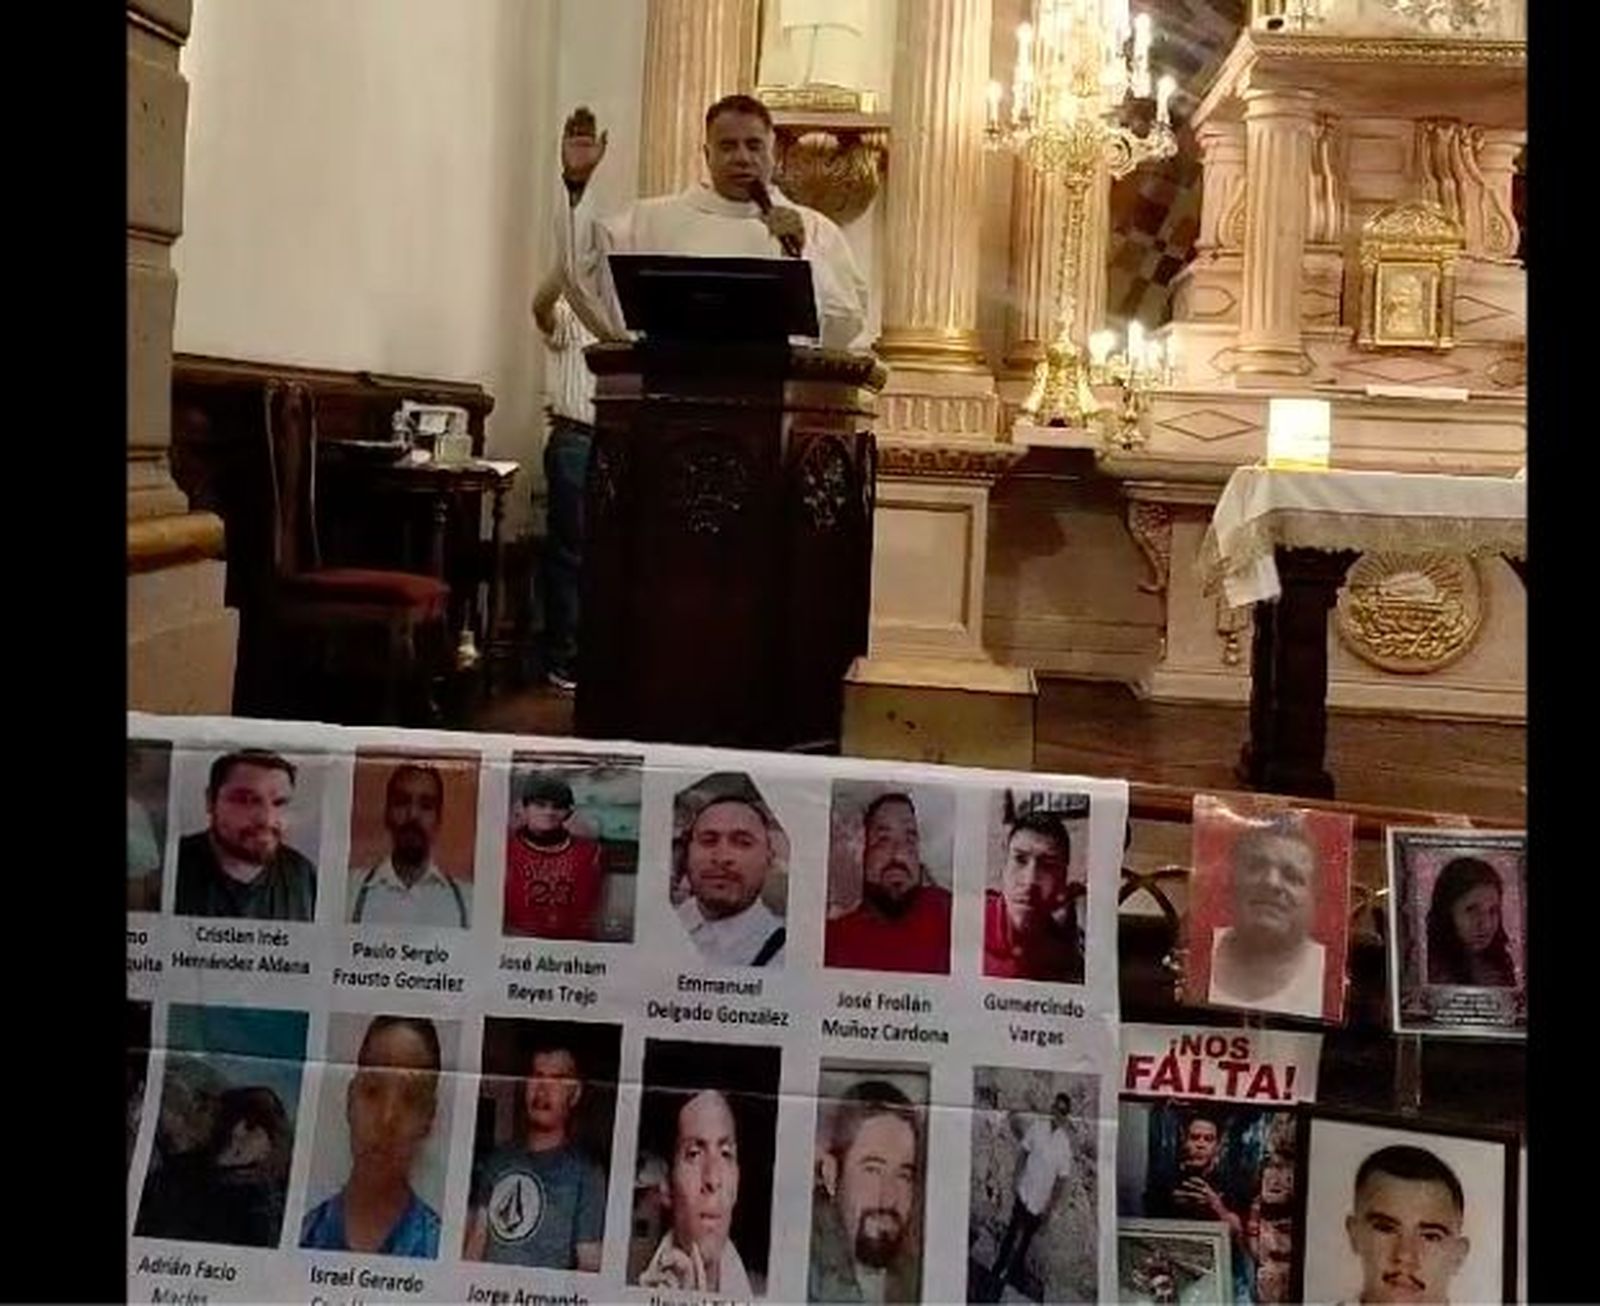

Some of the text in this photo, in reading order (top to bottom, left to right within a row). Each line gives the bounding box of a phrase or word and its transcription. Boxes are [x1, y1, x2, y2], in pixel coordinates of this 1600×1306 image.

[352, 941, 449, 965] Paulo Sergio
[499, 953, 607, 976] José Abraham
[332, 968, 465, 993] Frausto González
[677, 974, 763, 996] Emmanuel
[507, 982, 554, 1004] Reyes
[837, 991, 932, 1014] José Froilán
[647, 1000, 713, 1023] Delgado
[983, 993, 1085, 1019] Gumercindo
[821, 1019, 950, 1045] Muñoz Cardona
[1008, 1024, 1064, 1048] Vargas
[1169, 1032, 1251, 1060] ¡NOS
[1124, 1052, 1298, 1102] FALTA!
[137, 1255, 191, 1278] Adrián
[310, 1265, 424, 1294] Israel Gerardo
